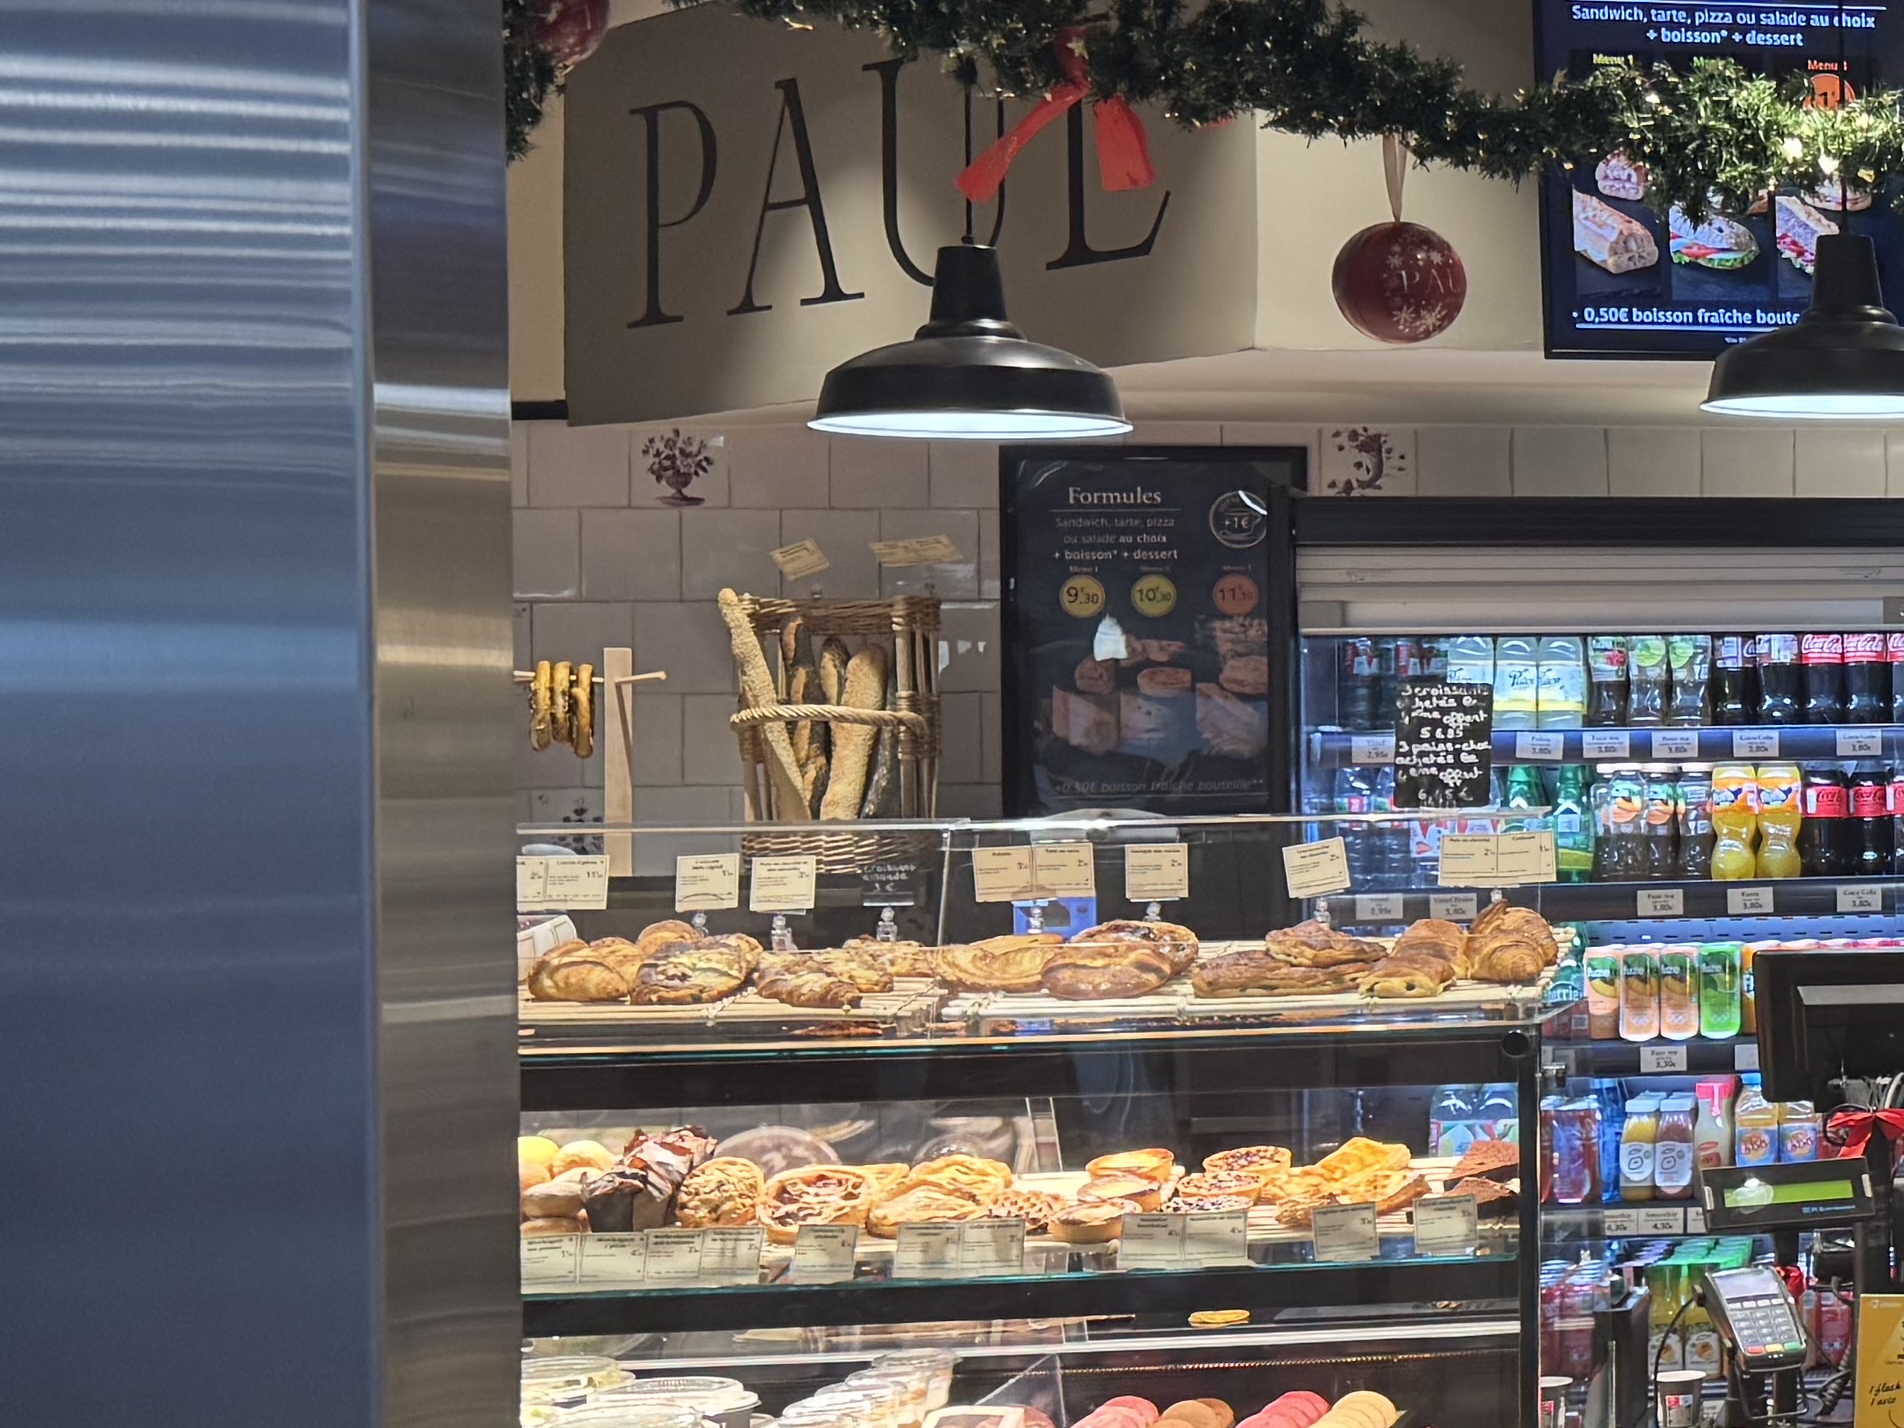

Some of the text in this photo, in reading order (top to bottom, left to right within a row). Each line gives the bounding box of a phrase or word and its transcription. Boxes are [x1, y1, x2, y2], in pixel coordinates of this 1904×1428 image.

[1572, 5, 1647, 24] Sandwich,
[1651, 9, 1691, 24] tarte,
[1695, 9, 1732, 26] pizza
[1736, 13, 1756, 25] ou
[1760, 11, 1806, 26] salade
[1810, 16, 1829, 27] au
[1746, 30, 1804, 46] dessert
[1633, 307, 1693, 324] boisson
[1698, 308, 1752, 325] fraîche
[1757, 309, 1801, 325] boute
[1068, 486, 1162, 504] Formules
[1119, 535, 1133, 543] au
[1136, 533, 1167, 543] choix
[1133, 549, 1178, 560] dessert
